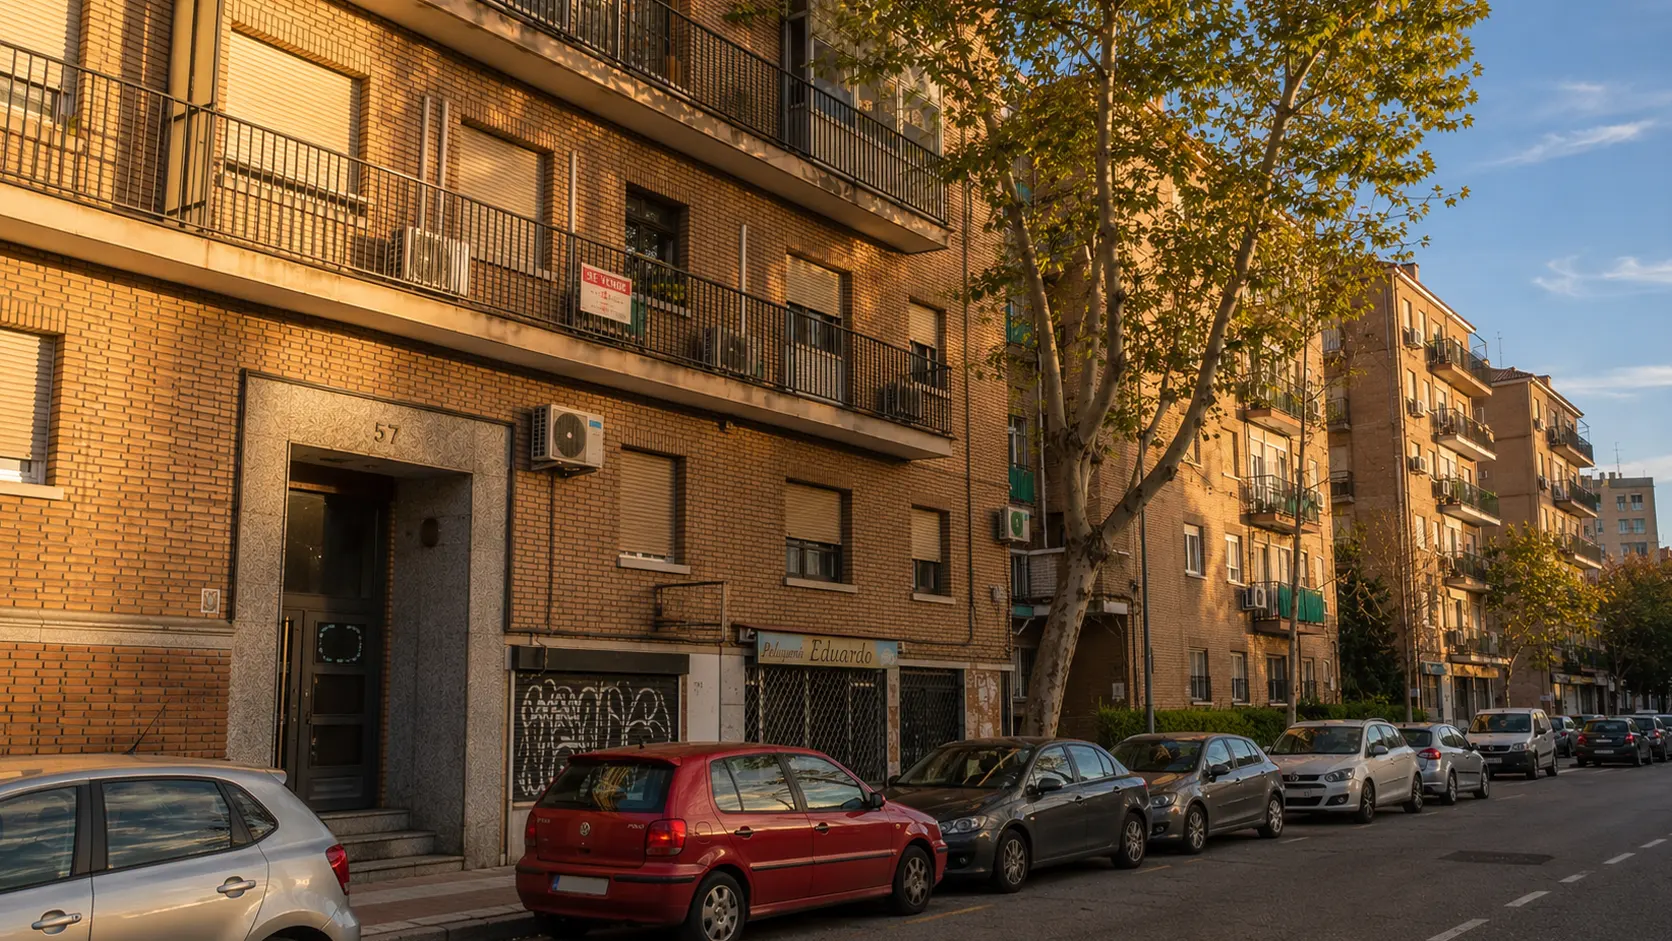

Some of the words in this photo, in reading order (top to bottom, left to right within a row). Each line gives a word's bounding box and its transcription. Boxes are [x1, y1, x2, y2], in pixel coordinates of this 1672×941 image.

[586, 271, 598, 284] SE
[600, 275, 627, 293] VENDE
[374, 422, 401, 445] 57
[809, 639, 872, 664] Eduardo
